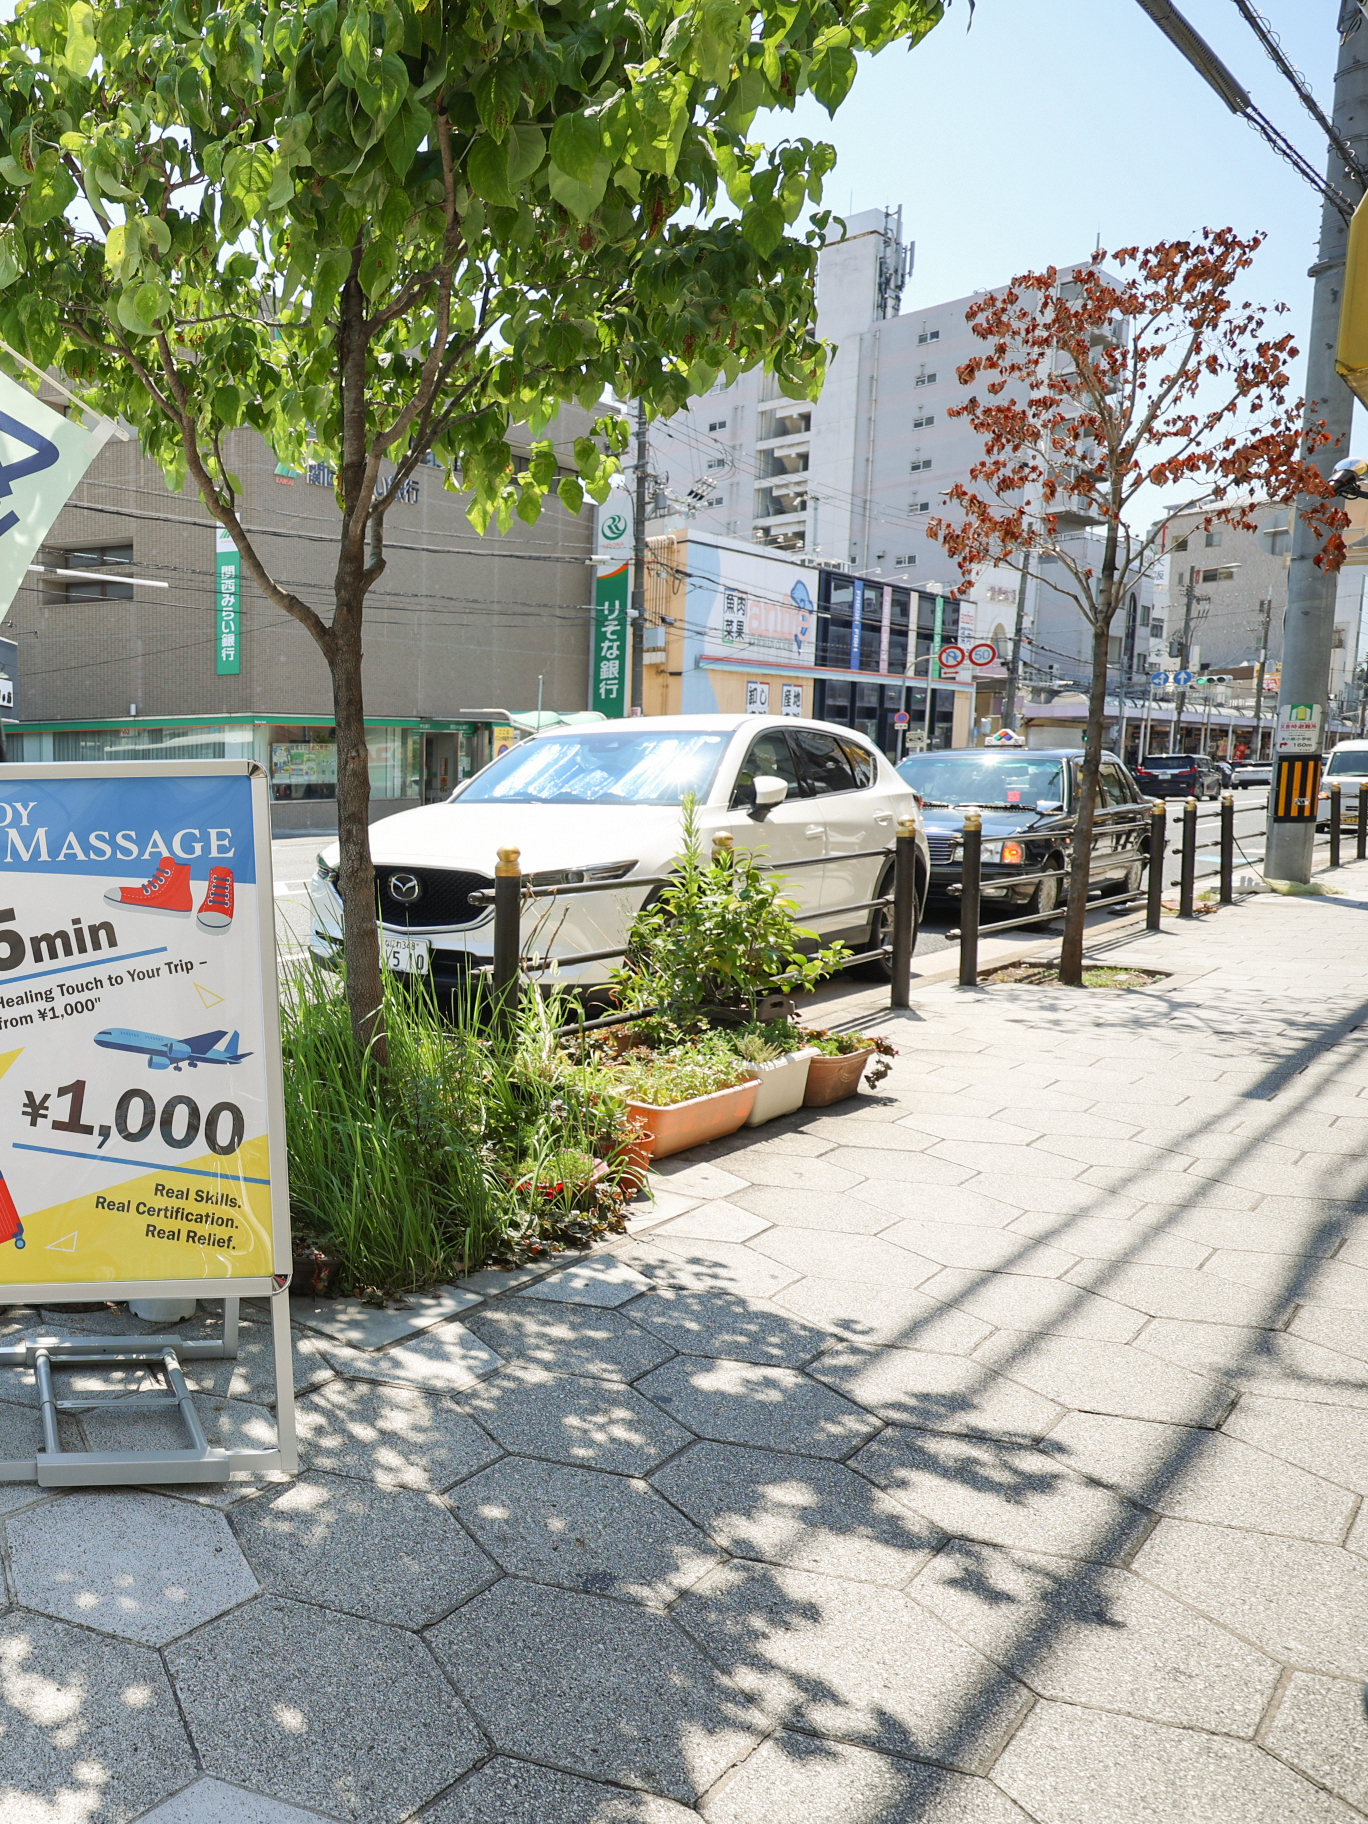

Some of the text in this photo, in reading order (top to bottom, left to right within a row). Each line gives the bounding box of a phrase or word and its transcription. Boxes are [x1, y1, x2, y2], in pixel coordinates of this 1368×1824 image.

[221, 565, 236, 661] 関西みらい銀行
[599, 600, 620, 698] りそな銀行
[974, 649, 991, 661] 50
[4, 827, 236, 862] MASSAGE
[57, 977, 104, 998] Touch
[107, 974, 124, 988] to
[127, 965, 162, 984] Your
[164, 958, 194, 978] Trip
[37, 996, 102, 1023] ¥1,000"
[21, 1079, 245, 1156] ¥1,000
[95, 1195, 240, 1230] Real Certification.
[154, 1183, 243, 1209] Real Skills.
[145, 1224, 237, 1251] Real Relief.
